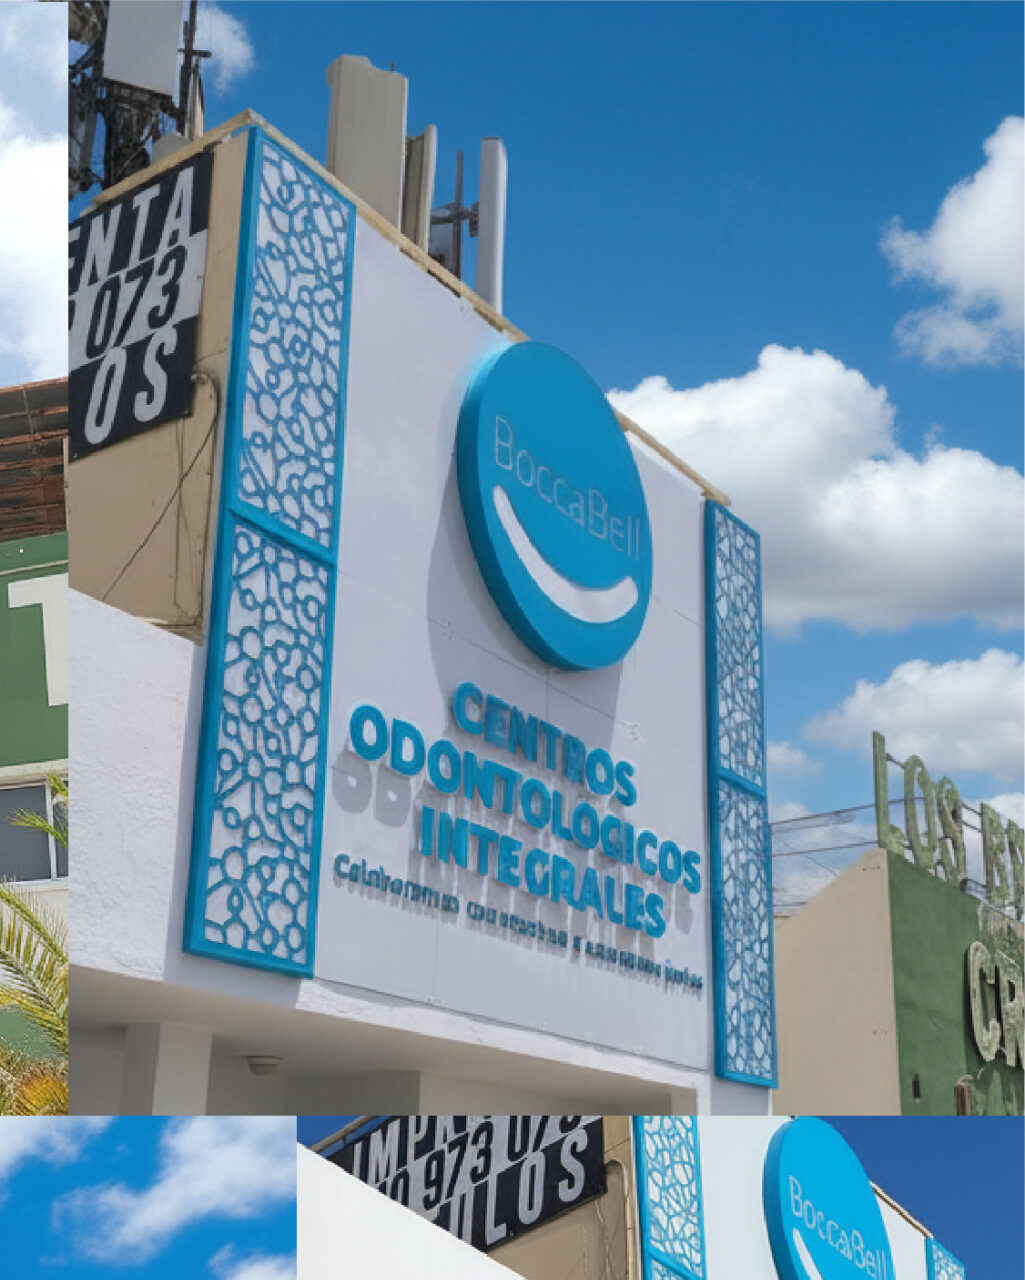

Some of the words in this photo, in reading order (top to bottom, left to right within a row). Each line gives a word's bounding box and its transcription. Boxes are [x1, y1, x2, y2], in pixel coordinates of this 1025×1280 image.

[68, 166, 194, 292] NTA
[86, 245, 188, 359] 073
[495, 415, 640, 561] BoccaBell
[452, 681, 637, 807] CENTROS
[420, 805, 667, 939] INTEGRALES
[423, 1121, 494, 1210] 973
